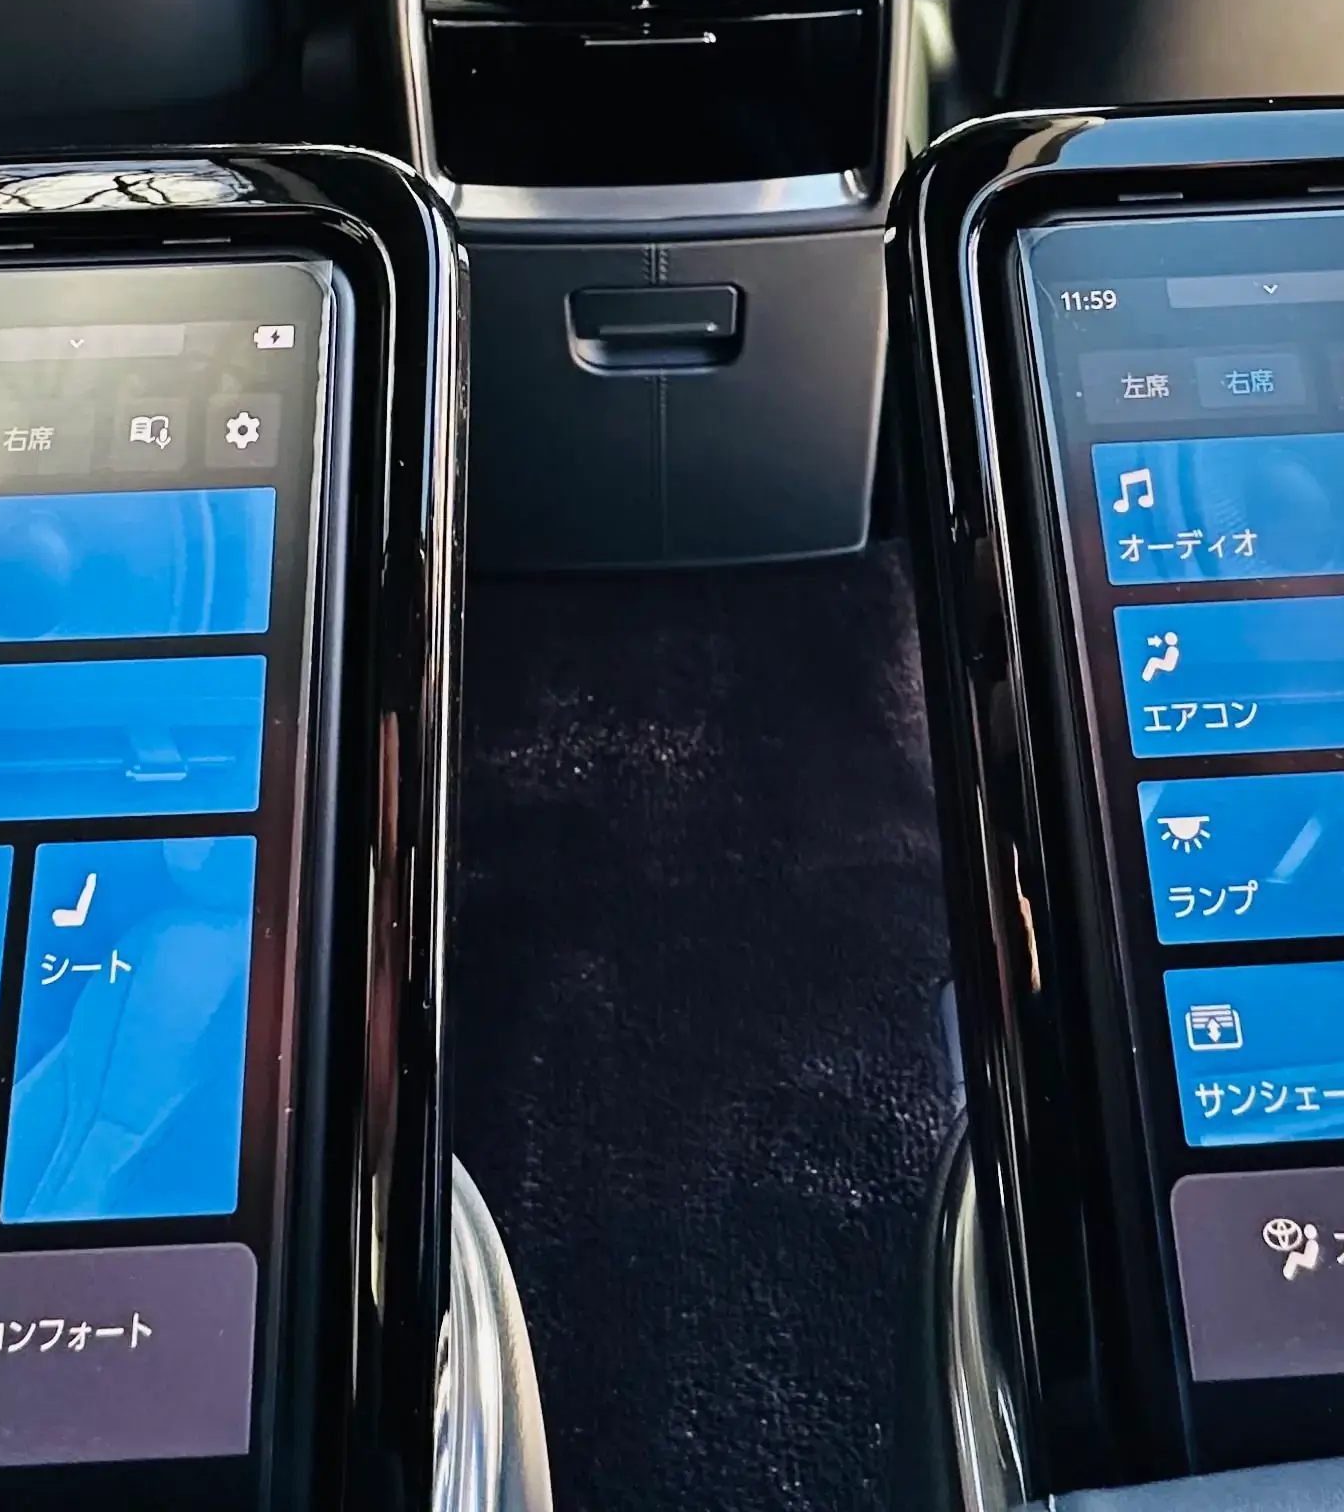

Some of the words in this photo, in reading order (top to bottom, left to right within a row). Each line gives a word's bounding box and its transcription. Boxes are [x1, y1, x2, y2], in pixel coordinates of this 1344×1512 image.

[1059, 289, 1117, 314] 11:59
[1121, 373, 1170, 400] 左席
[1225, 368, 1275, 395] 右席
[2, 425, 54, 453] 右席
[1118, 528, 1259, 562] オーディオ
[1142, 700, 1259, 733] エアコン
[1167, 879, 1259, 918] ランプ
[40, 949, 132, 986] シート
